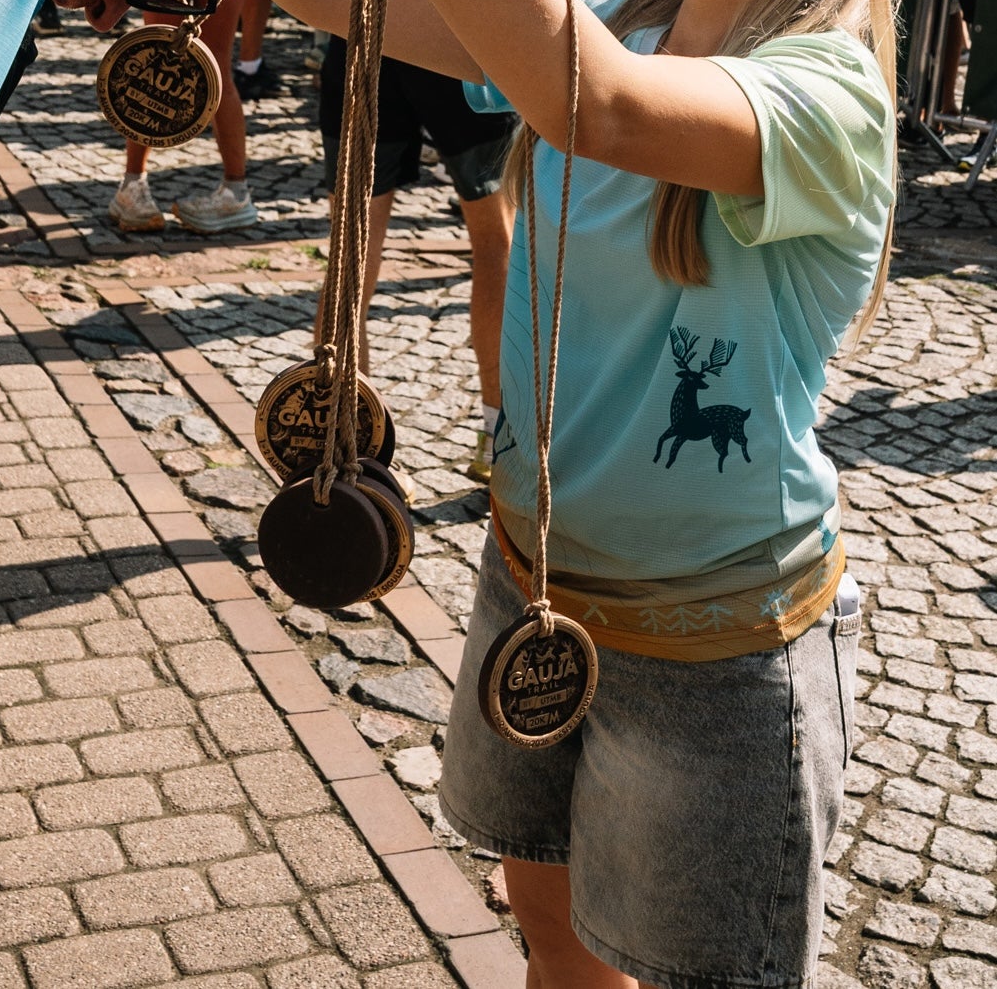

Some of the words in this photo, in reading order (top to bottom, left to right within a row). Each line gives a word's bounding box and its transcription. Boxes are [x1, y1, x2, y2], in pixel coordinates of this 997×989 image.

[123, 58, 196, 106] GAUJA
[382, 564, 406, 592] SIGULDA
[507, 657, 579, 691] GAUJA
[527, 682, 560, 694] TRAIL
